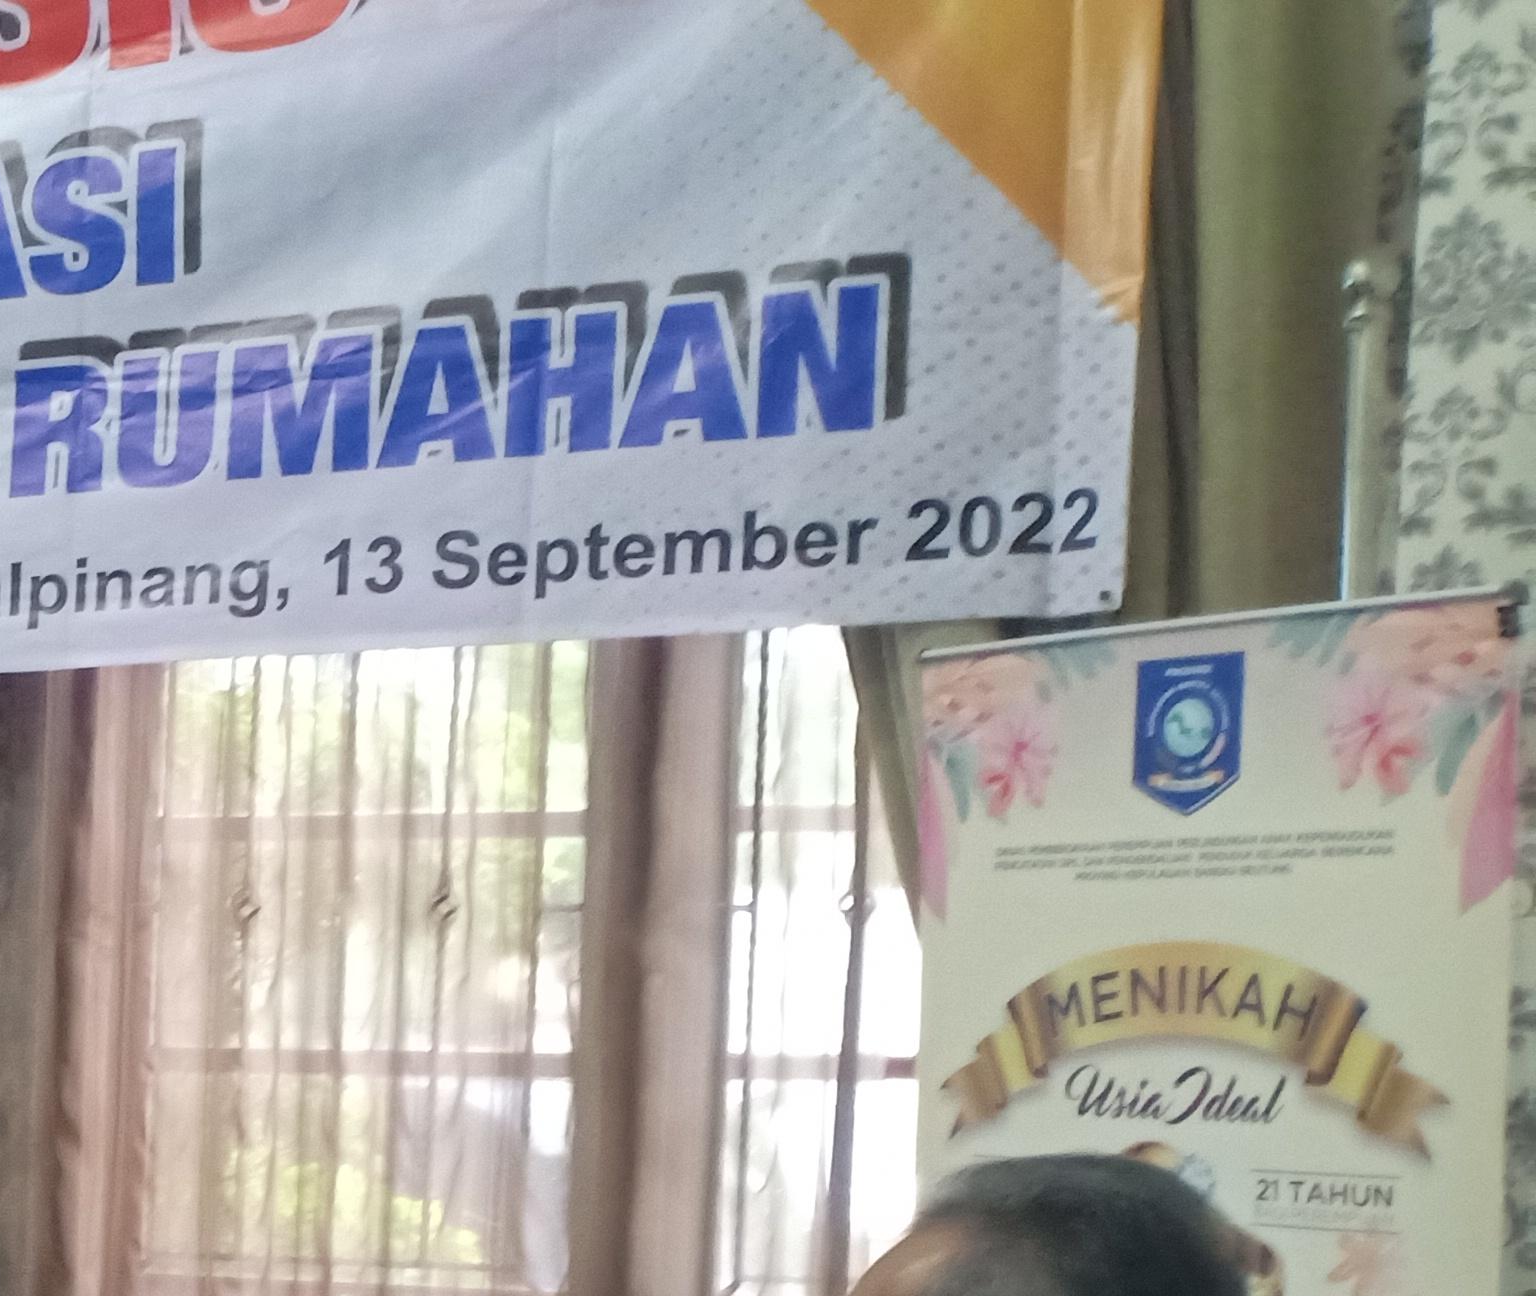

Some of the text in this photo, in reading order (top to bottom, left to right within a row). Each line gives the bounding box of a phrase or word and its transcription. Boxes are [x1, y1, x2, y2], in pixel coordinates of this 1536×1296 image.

[8, 281, 880, 496] RUMAHAN
[324, 536, 403, 597] 13
[432, 510, 879, 599] September
[904, 487, 1099, 562] 2022
[1045, 966, 1318, 1041] MENIKAH
[1065, 1064, 1168, 1119] Usia
[1256, 1178, 1393, 1207] 21 TAHUN
